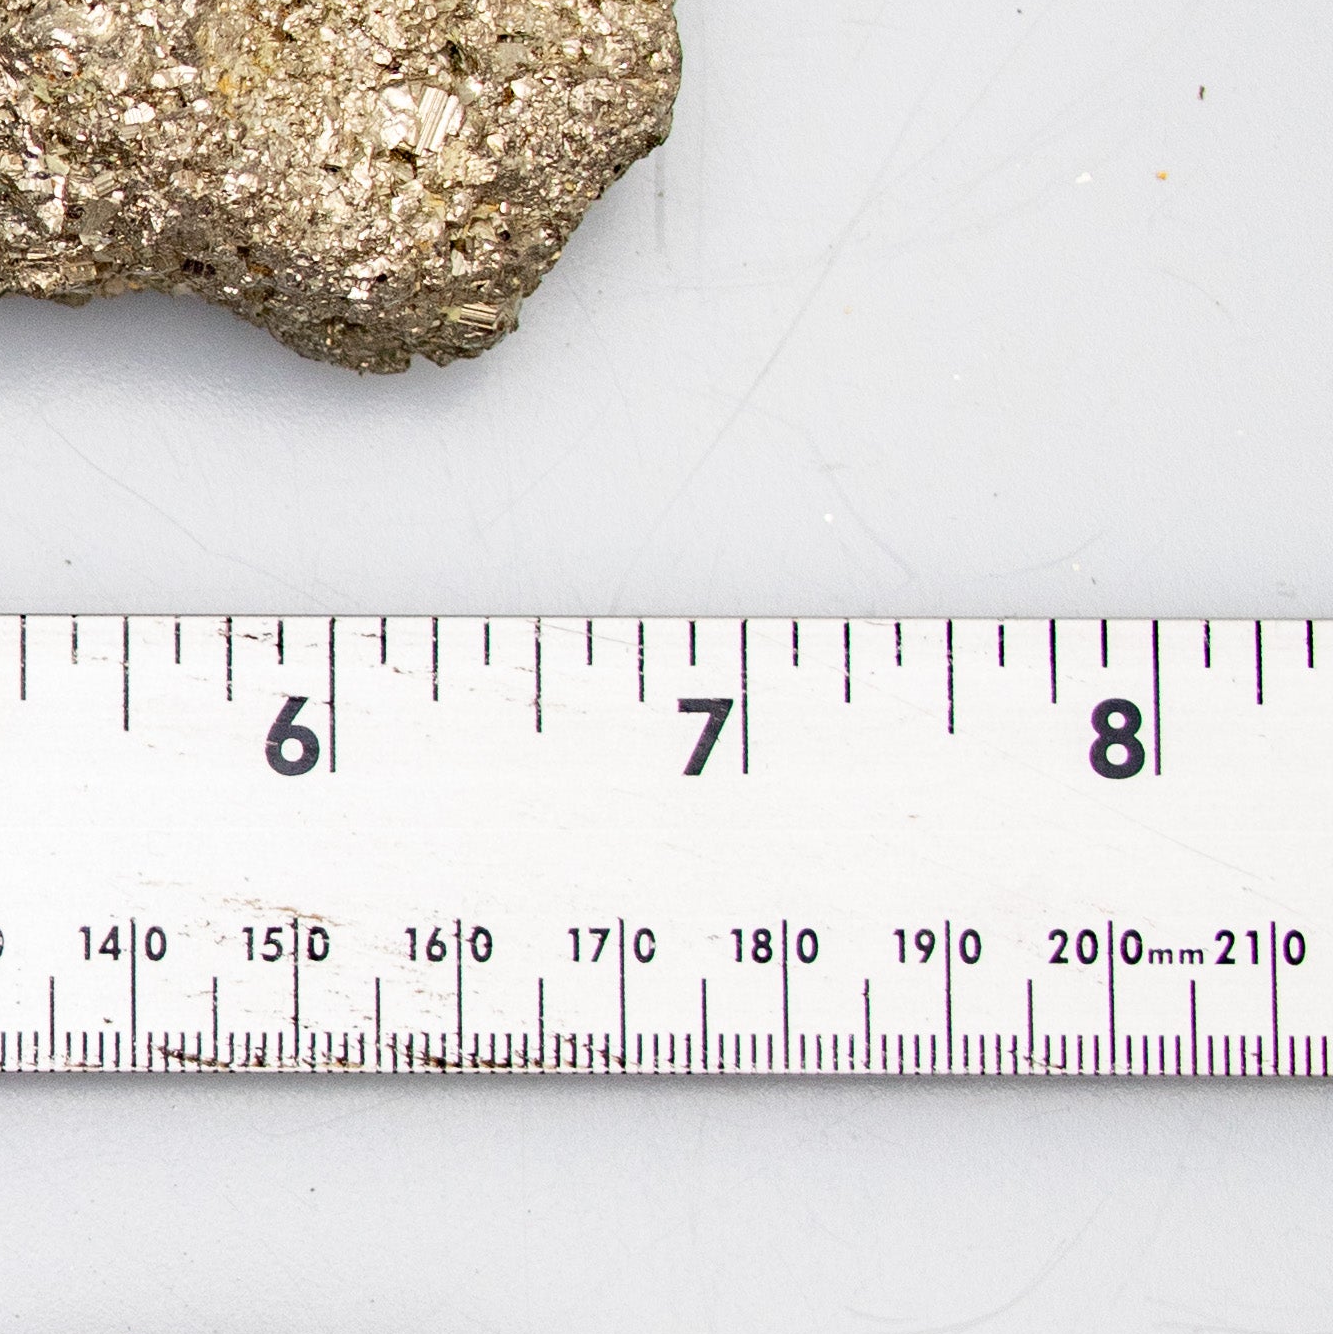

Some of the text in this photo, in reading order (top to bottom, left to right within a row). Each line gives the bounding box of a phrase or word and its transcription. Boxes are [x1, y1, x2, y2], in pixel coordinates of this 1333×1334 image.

[264, 696, 321, 777] 6
[677, 697, 734, 776] 7
[1088, 698, 1146, 780] 8
[78, 925, 167, 962] 140
[241, 926, 331, 963] 150
[404, 927, 493, 963] 160
[567, 927, 657, 964] 170
[730, 928, 819, 965] 180
[893, 928, 982, 965] 190
[1213, 929, 1306, 966] 210
